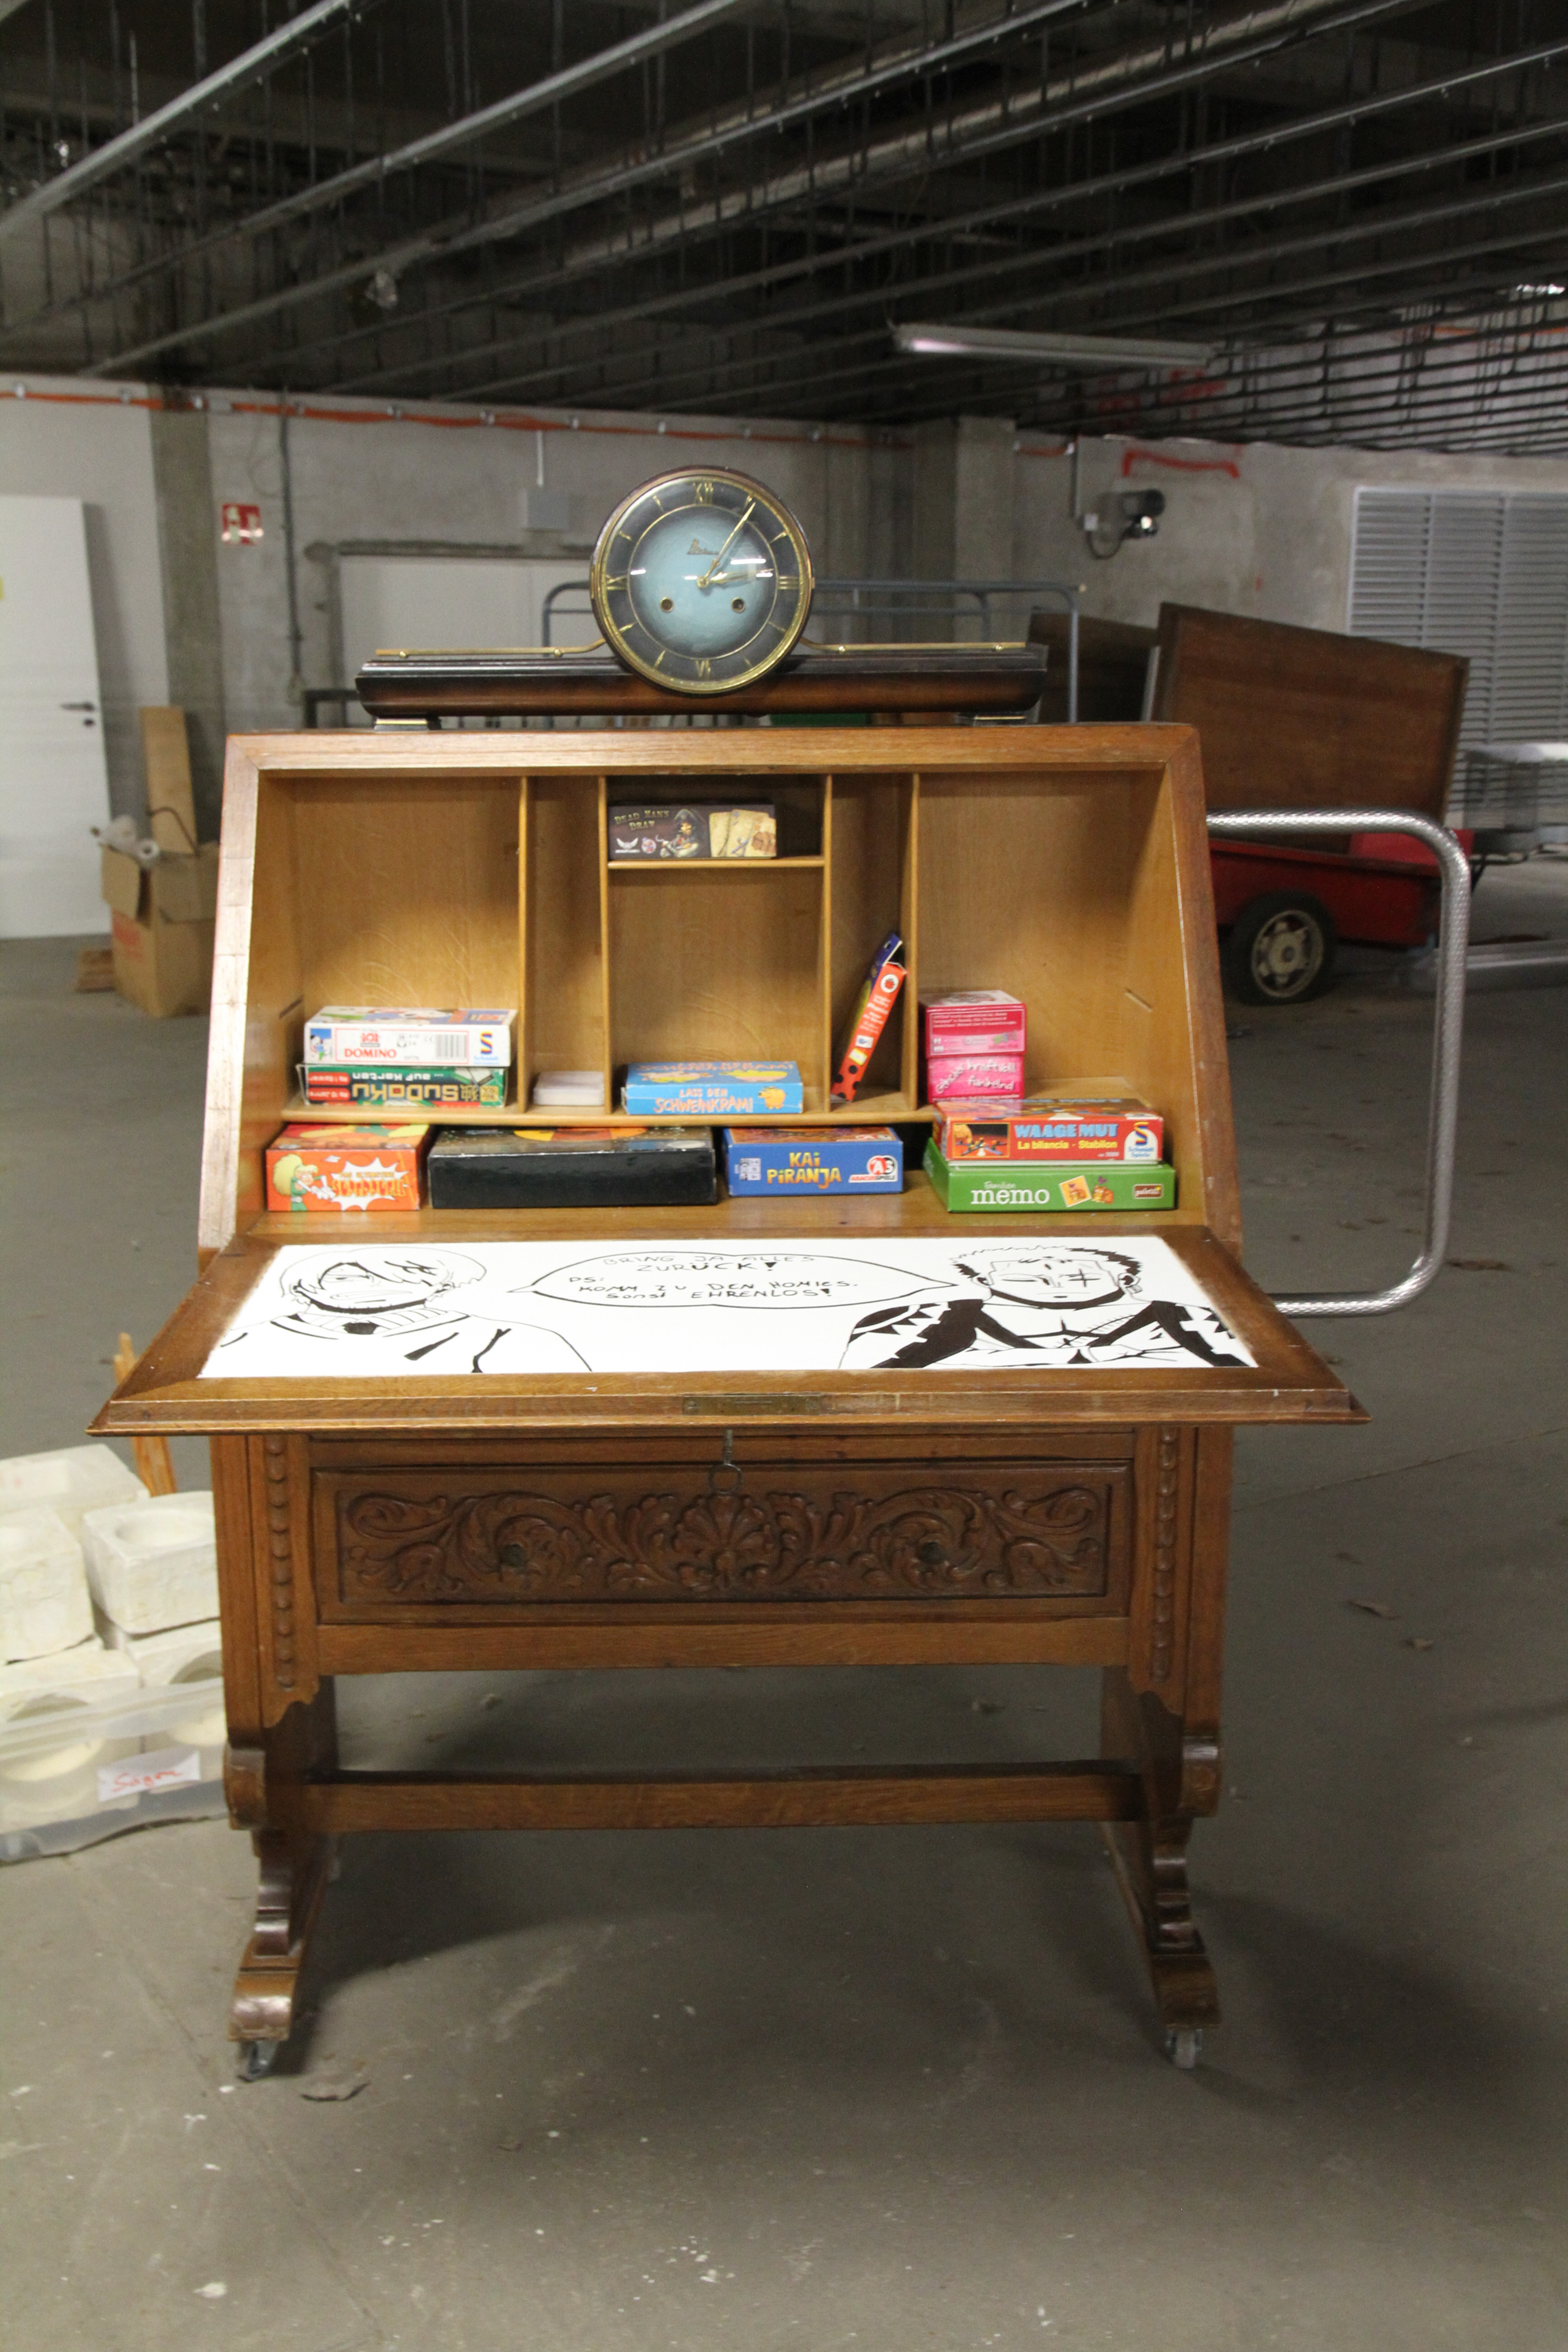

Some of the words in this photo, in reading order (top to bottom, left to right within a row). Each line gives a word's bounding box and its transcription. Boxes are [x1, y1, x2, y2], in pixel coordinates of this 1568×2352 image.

[615, 813, 640, 824] DEAD
[629, 820, 656, 830] DRAW
[344, 1049, 397, 1059] DOMINO
[352, 1072, 402, 1081] Karten
[679, 1088, 703, 1098] LASS
[707, 1088, 729, 1098] DEN
[1014, 1125, 1077, 1138] WAAGE
[1079, 1124, 1118, 1137] MUT
[1018, 1140, 1030, 1150] La
[971, 1189, 1051, 1205] memo
[603, 1255, 676, 1265] BRING
